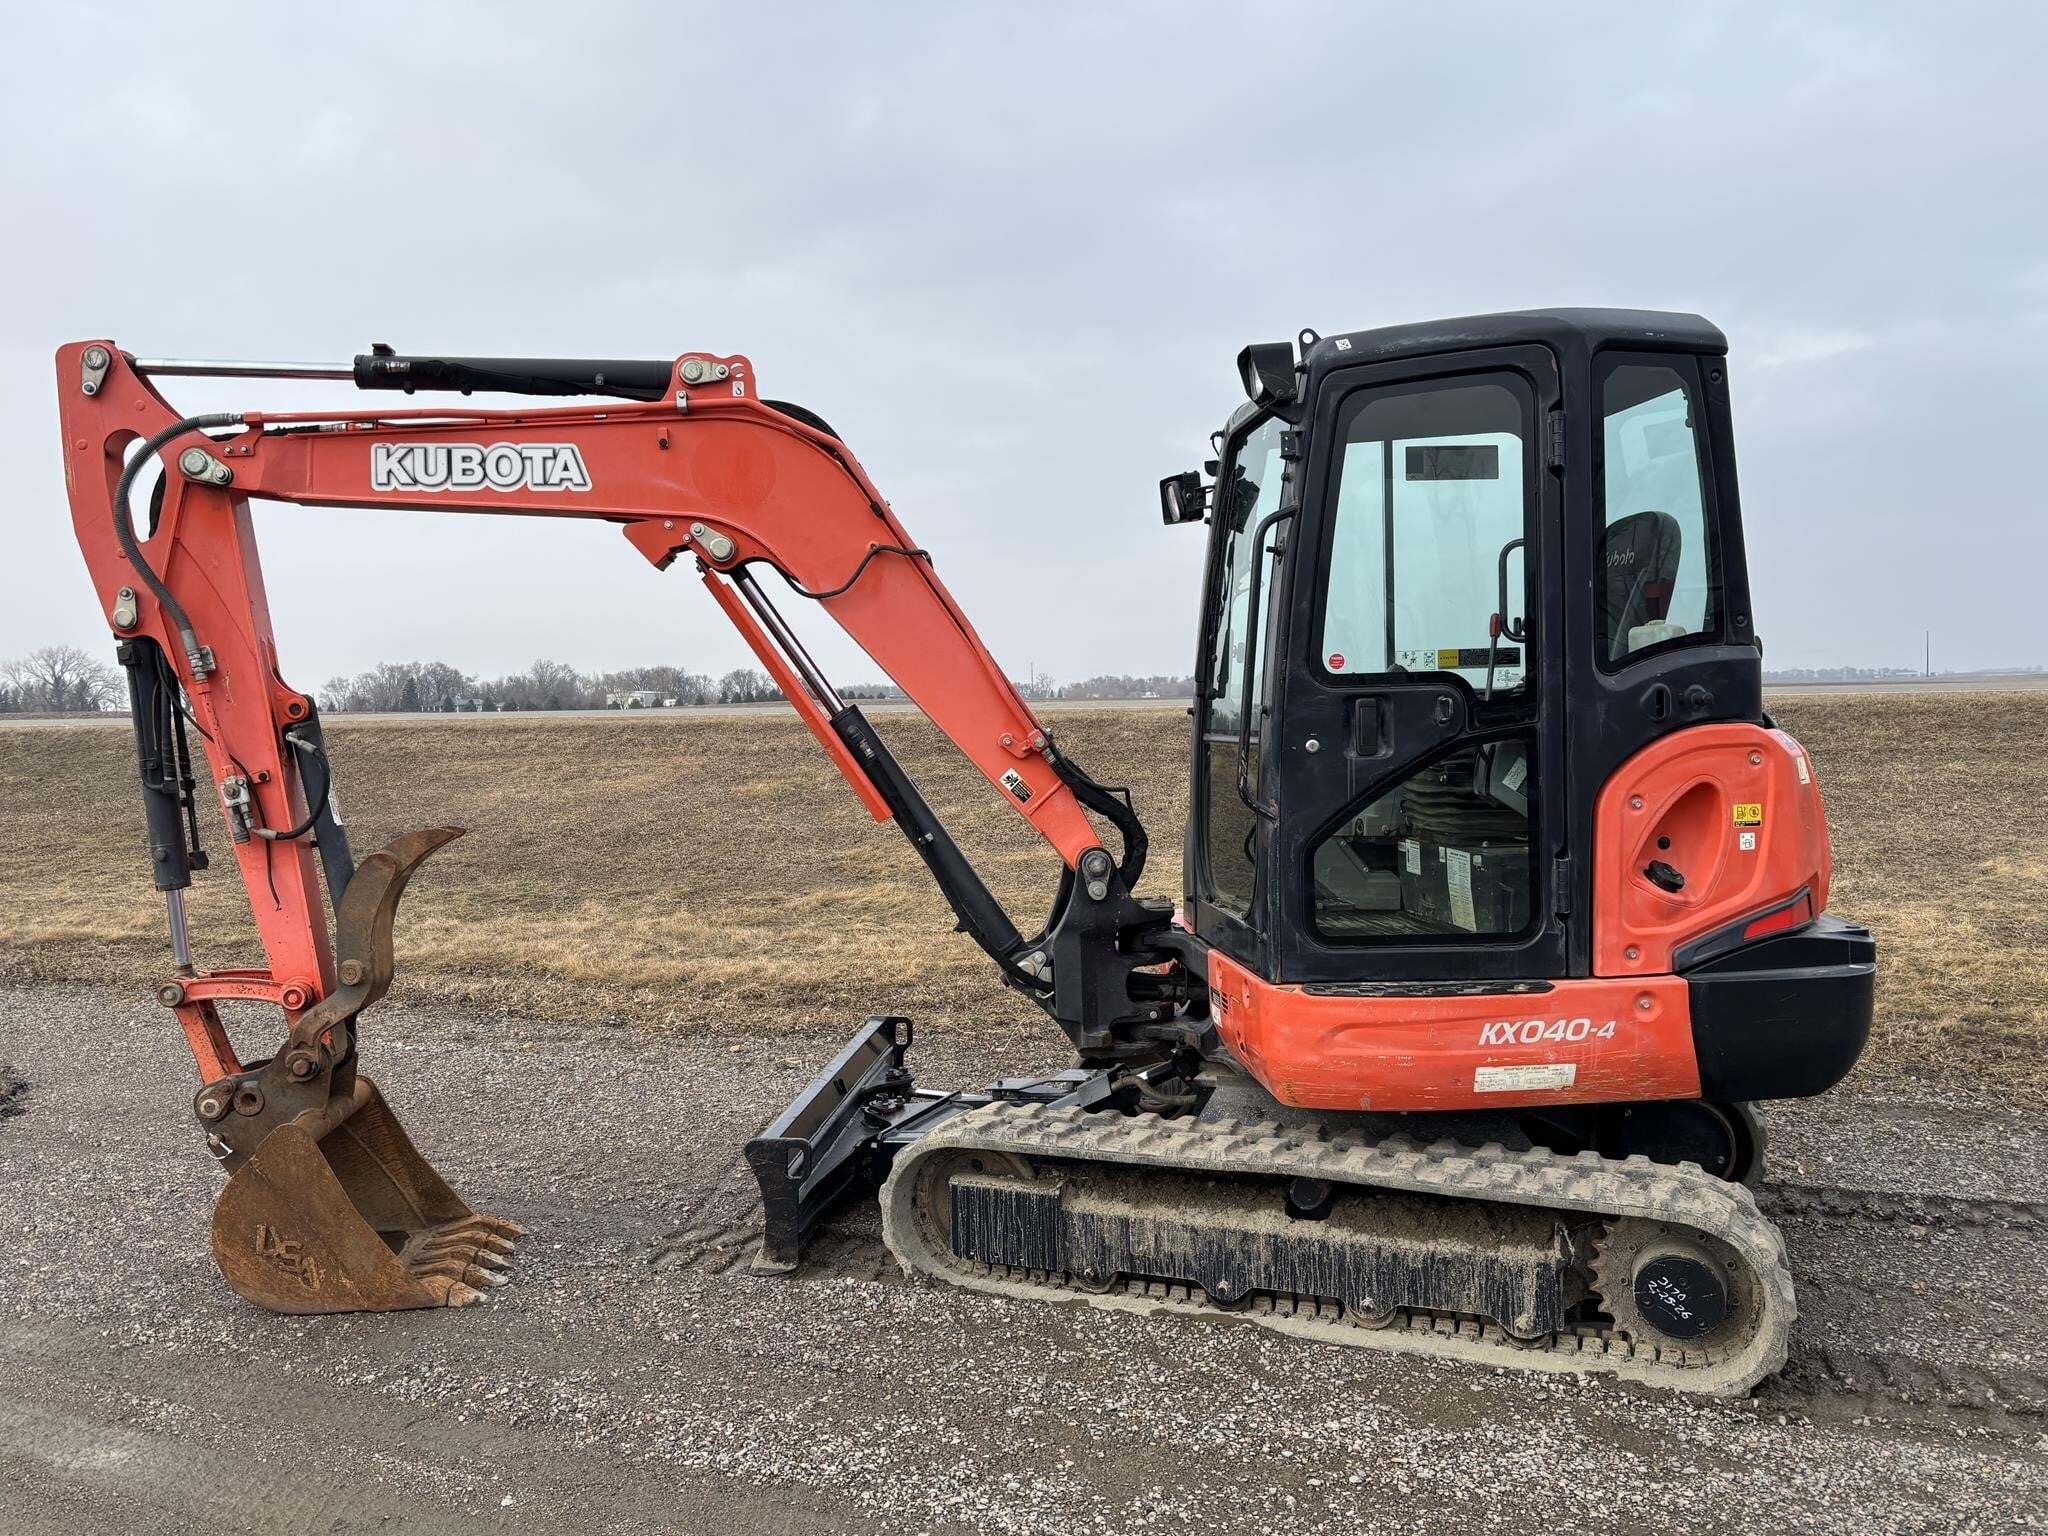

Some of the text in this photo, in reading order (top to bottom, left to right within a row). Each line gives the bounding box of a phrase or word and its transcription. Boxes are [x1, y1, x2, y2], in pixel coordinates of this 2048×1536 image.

[374, 445, 587, 488] KUBOTA
[1606, 548, 1635, 567] ubota
[1478, 1018, 1616, 1046] KX040-4
[1657, 1276, 1687, 1301] 3170
